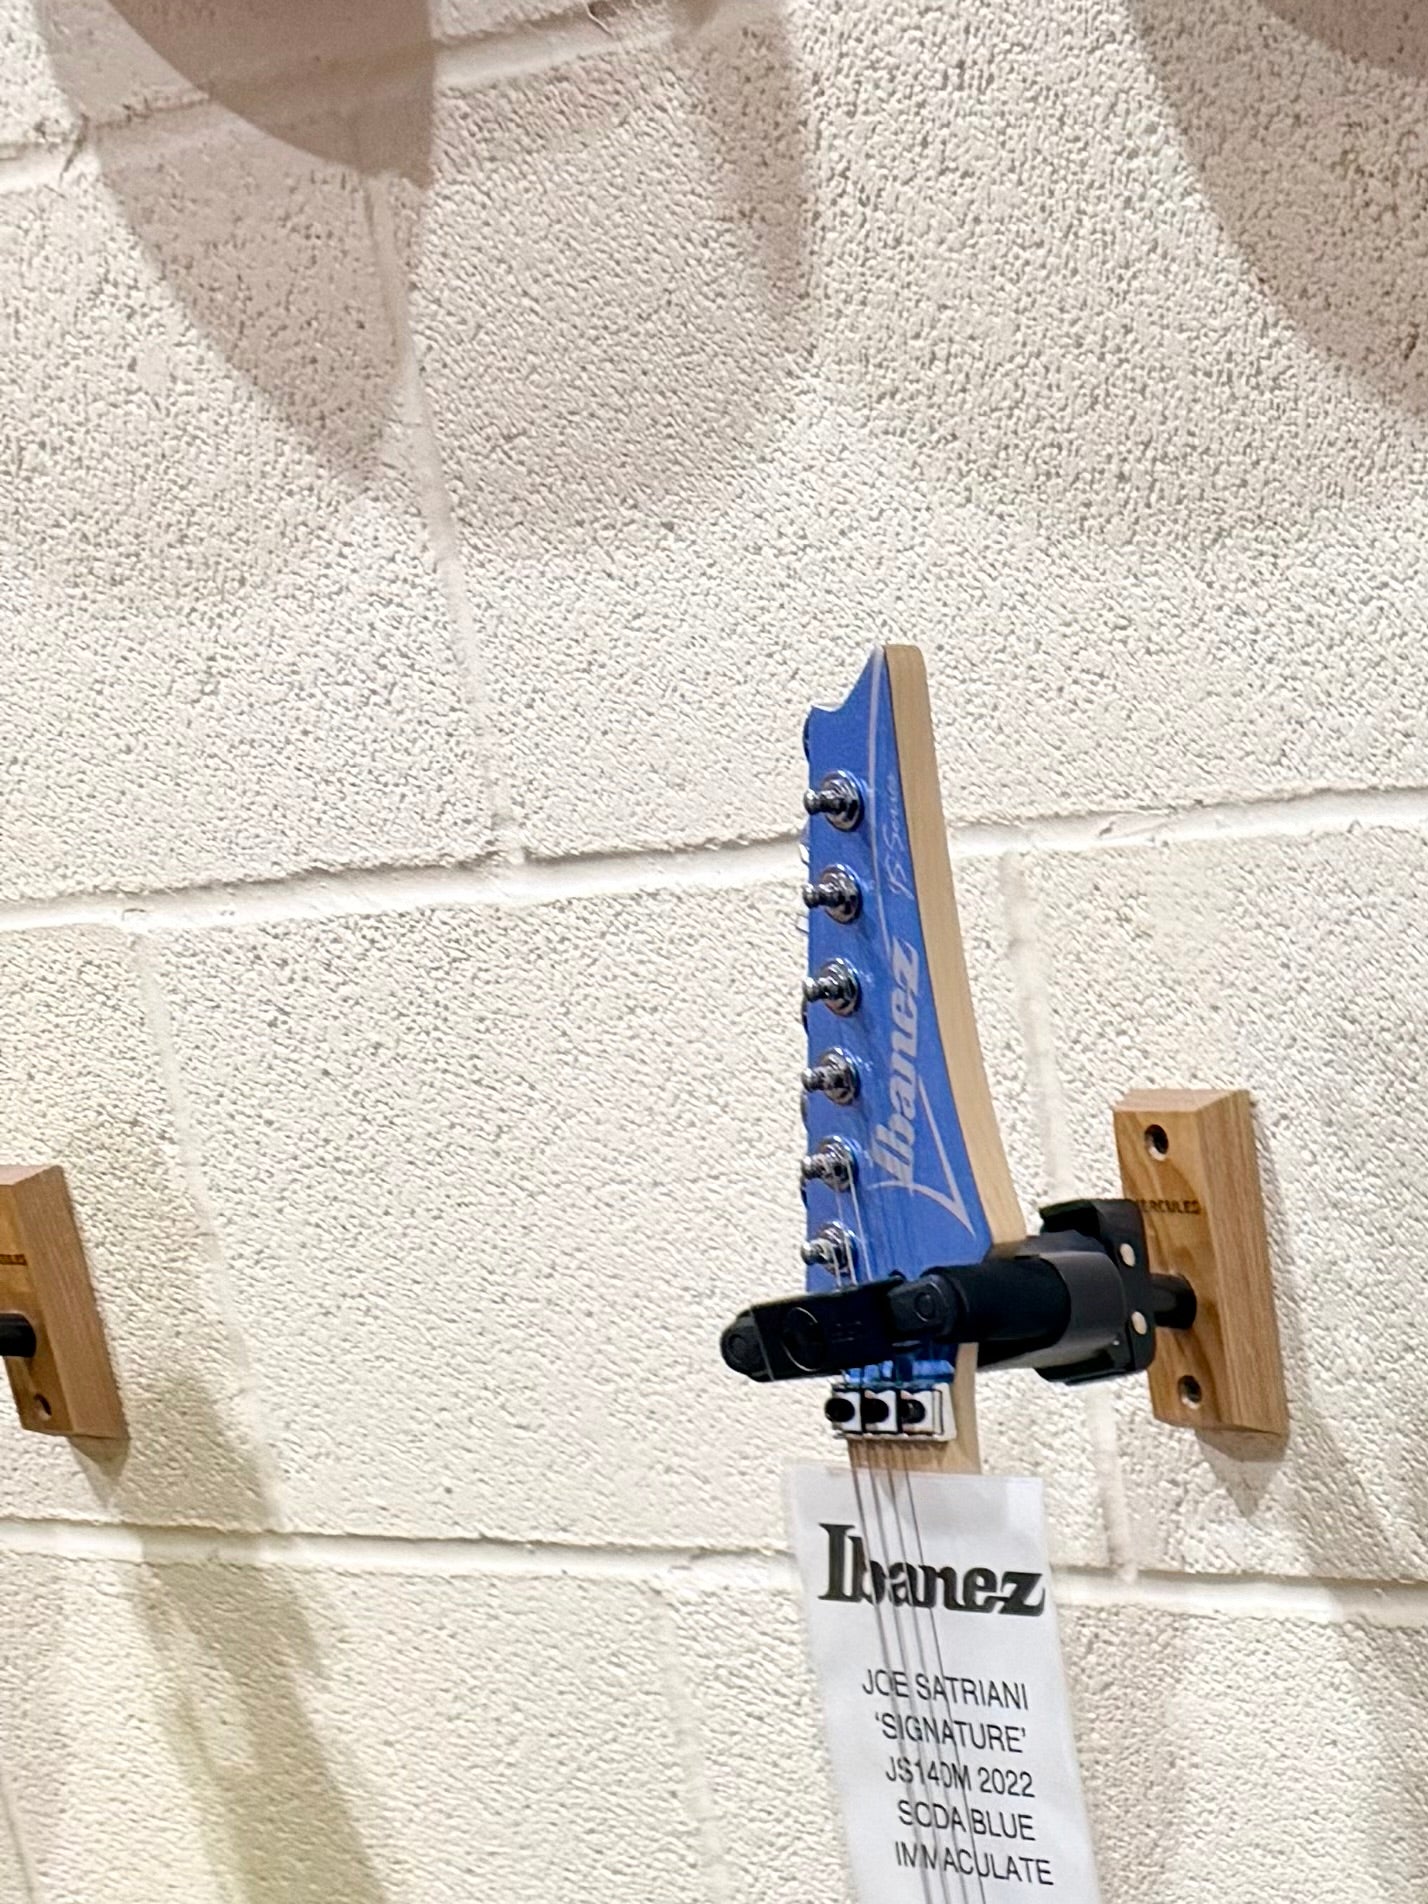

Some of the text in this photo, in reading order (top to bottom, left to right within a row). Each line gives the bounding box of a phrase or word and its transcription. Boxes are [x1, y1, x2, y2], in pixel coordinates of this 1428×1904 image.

[868, 936, 920, 1196] Ibanez
[817, 1522, 1046, 1618] Ibanez
[862, 1669, 1029, 1710] JOE SATRIANI
[977, 1766, 1036, 1799] 2022
[897, 1800, 1036, 1841] SODA BLUE
